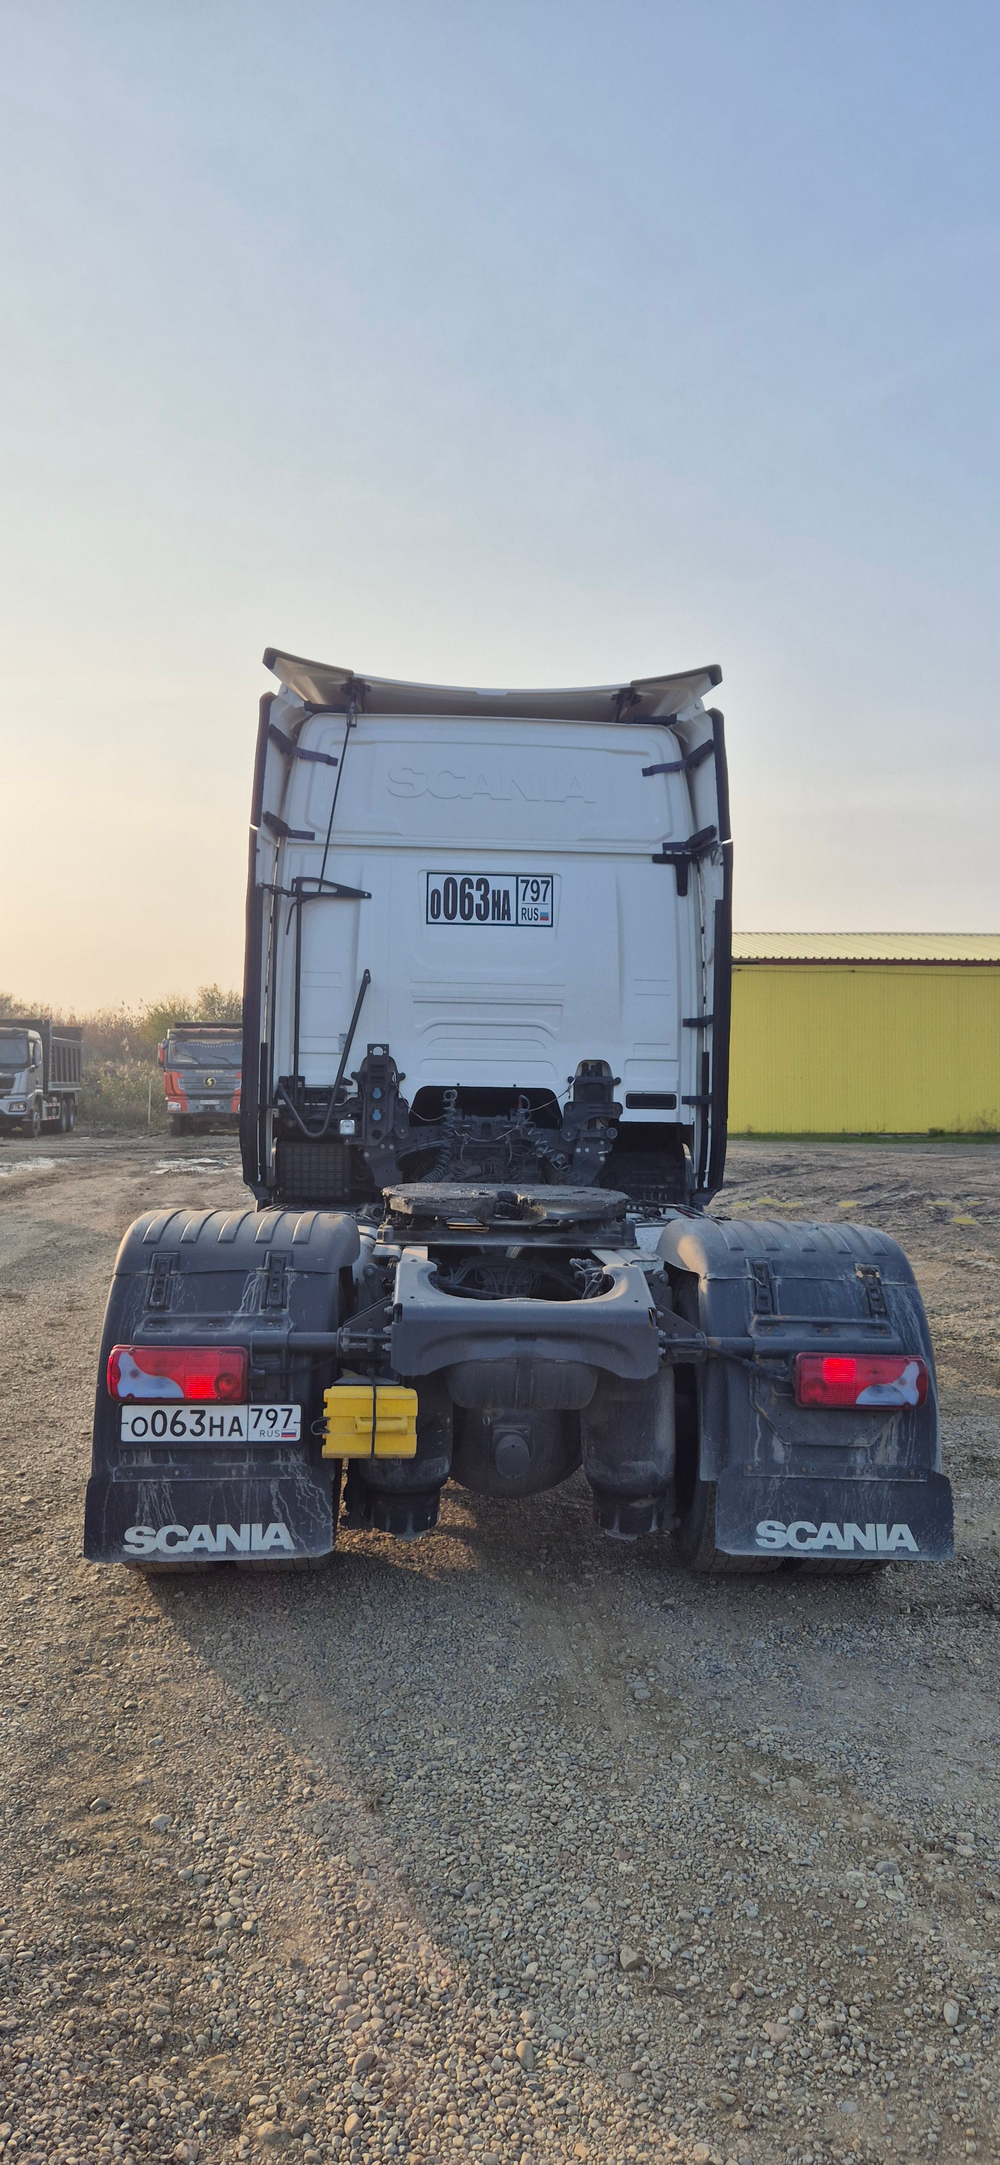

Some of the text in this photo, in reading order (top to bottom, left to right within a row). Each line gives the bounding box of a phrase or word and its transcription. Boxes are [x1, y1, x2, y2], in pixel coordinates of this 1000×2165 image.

[387, 767, 597, 804] SCANIA
[520, 879, 551, 902] 797
[521, 907, 539, 921] RUS
[250, 1408, 293, 1429] 797
[259, 1429, 281, 1438] RUS
[122, 1522, 296, 1555] SCANIA
[755, 1520, 920, 1552] SCANIA
